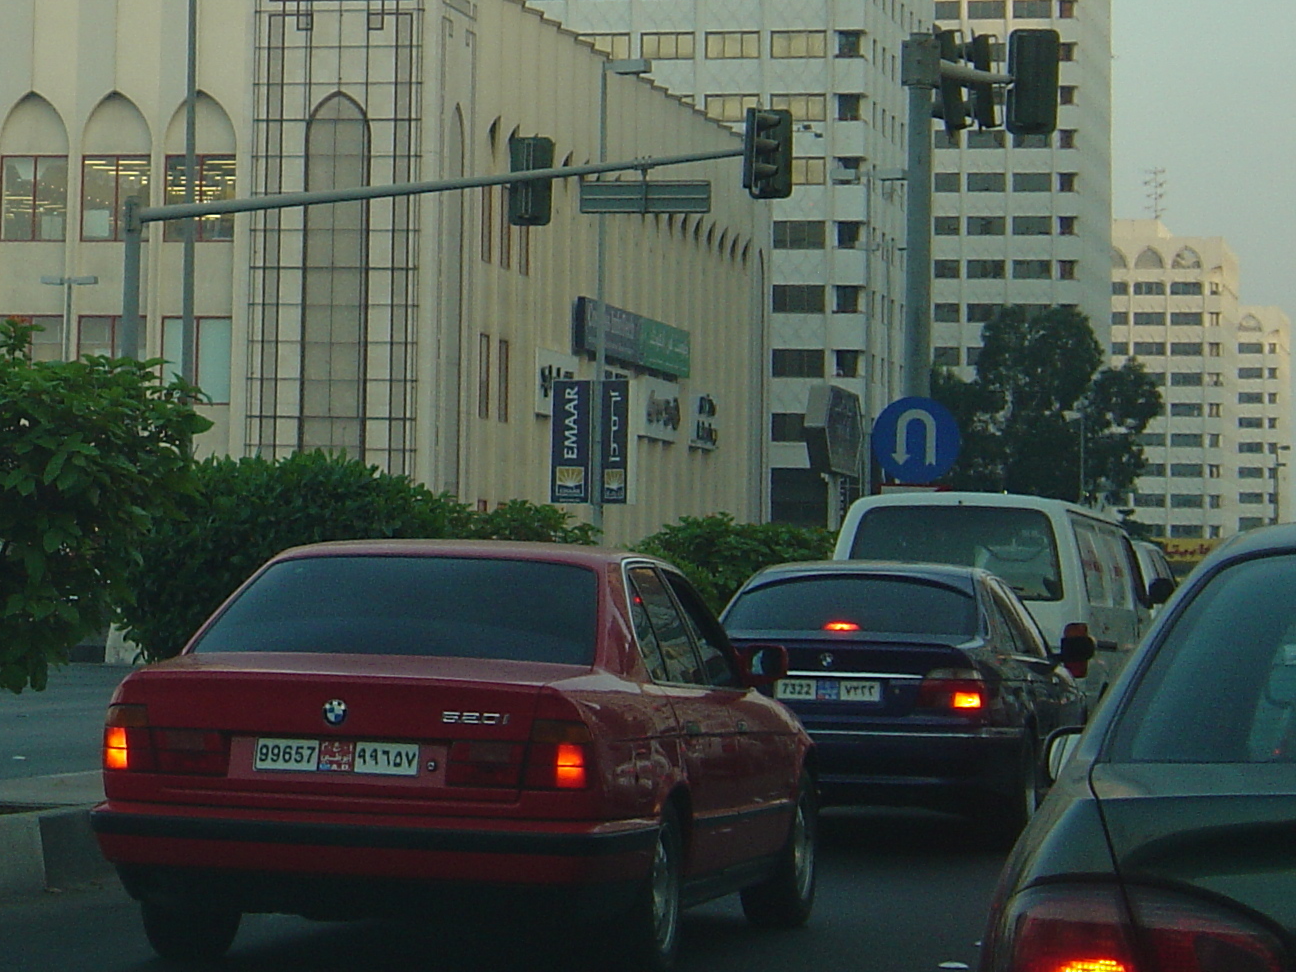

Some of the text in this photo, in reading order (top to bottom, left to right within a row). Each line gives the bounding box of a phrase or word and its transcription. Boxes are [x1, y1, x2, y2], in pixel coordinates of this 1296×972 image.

[563, 386, 578, 460] EMAAR
[782, 682, 812, 696] 7322
[442, 711, 510, 726] 520i
[258, 744, 317, 764] 99657
[357, 746, 417, 768] ٩٩٦٥٧
